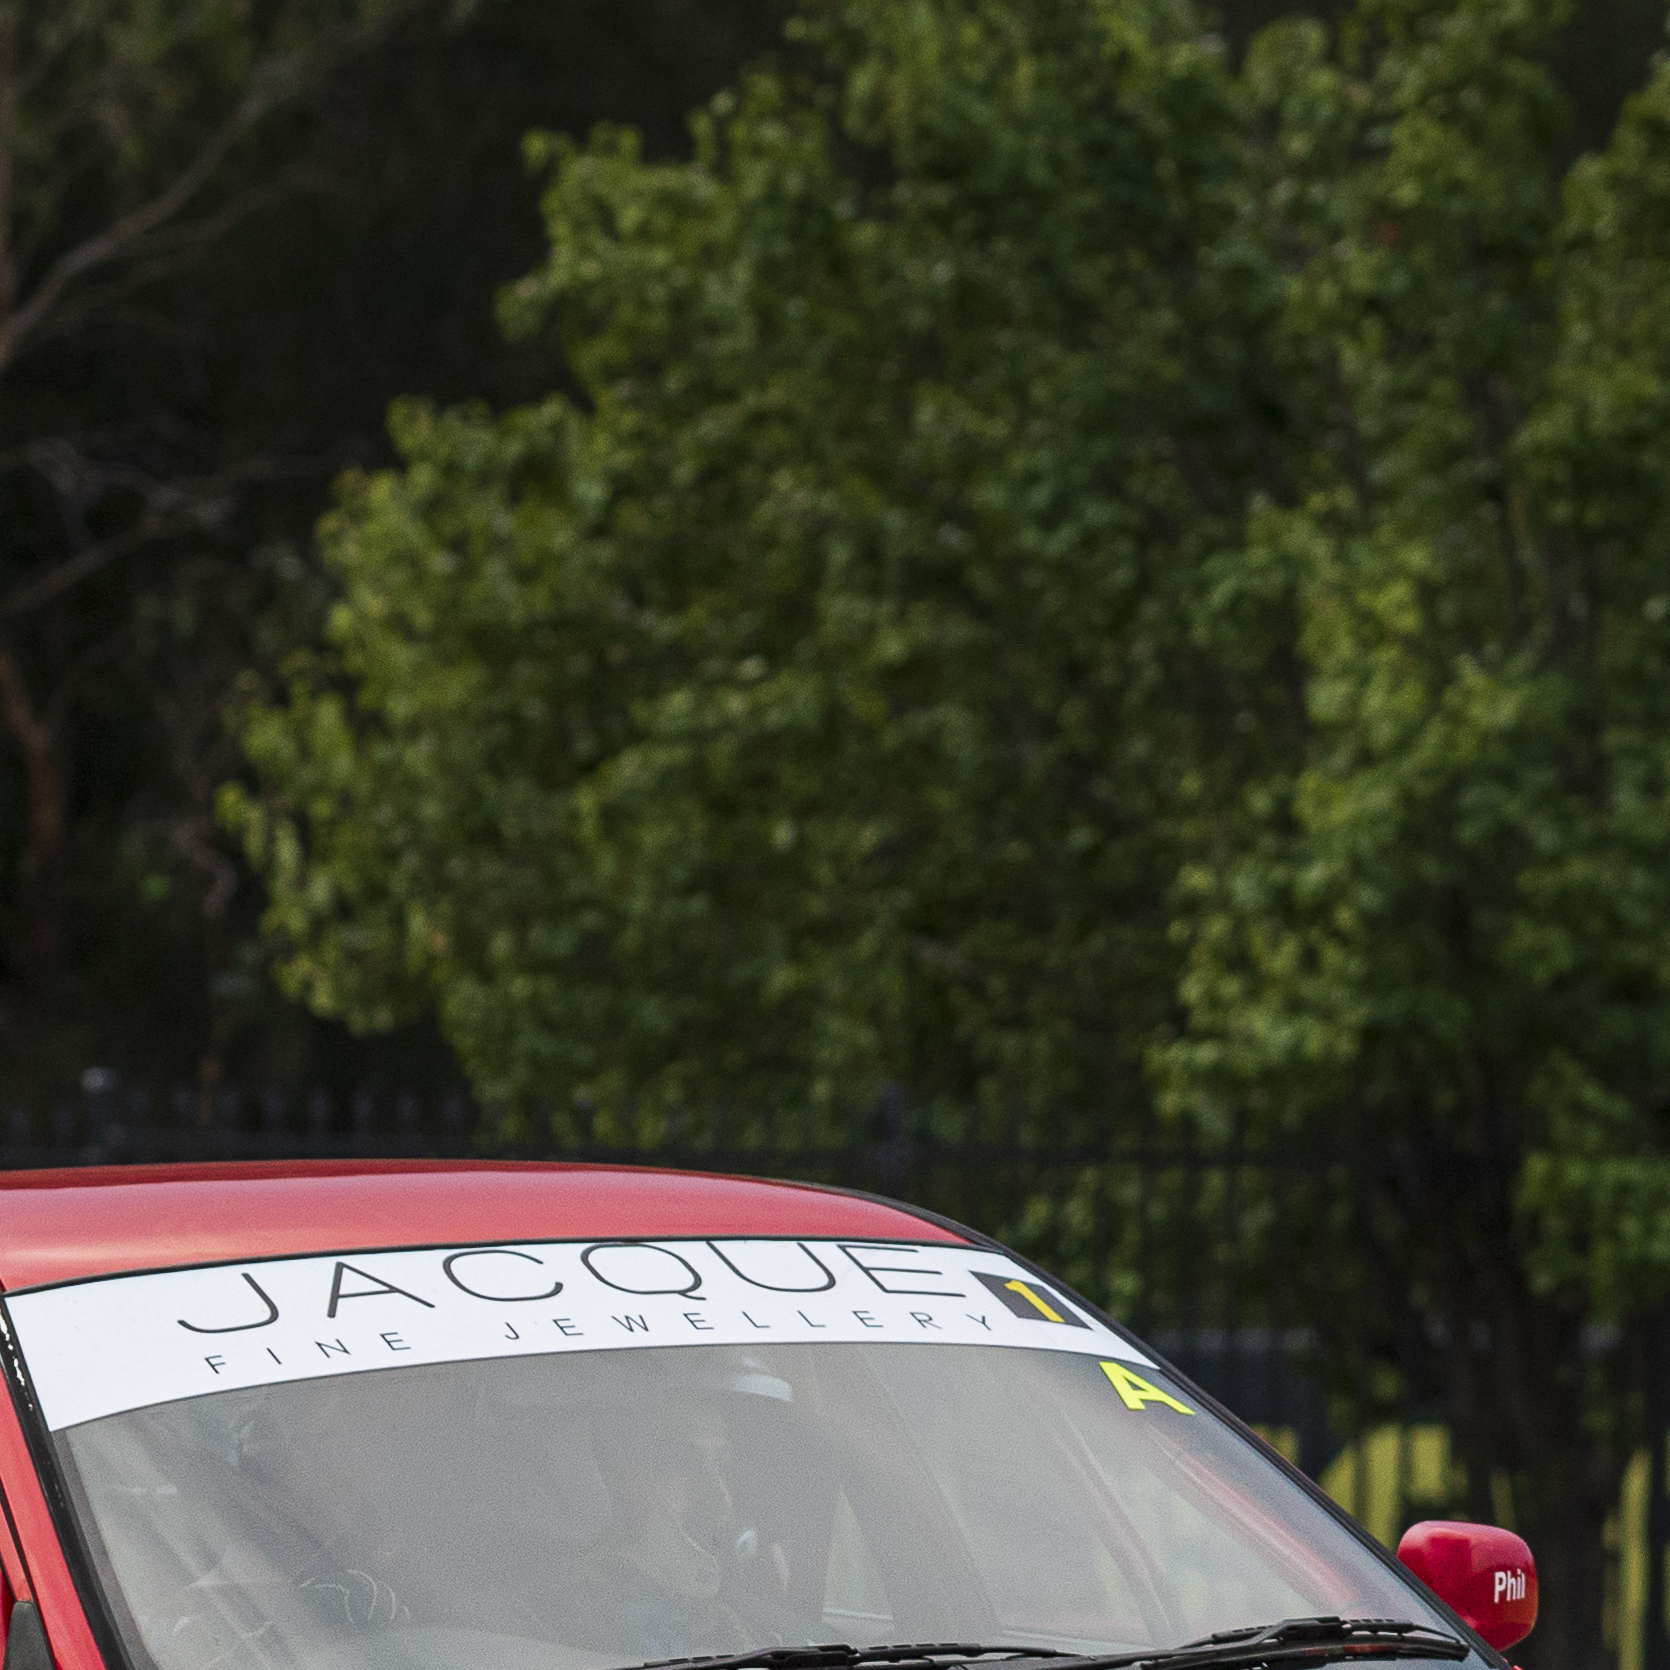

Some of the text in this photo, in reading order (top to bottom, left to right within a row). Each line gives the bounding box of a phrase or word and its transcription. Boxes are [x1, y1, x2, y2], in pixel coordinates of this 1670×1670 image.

[177, 1240, 967, 1334] JACQUE
[1004, 1280, 1066, 1323] 1
[204, 1308, 993, 1375] FINE JEWELLERY
[1098, 1361, 1197, 1415] A
[1493, 1567, 1526, 1604] Phil
